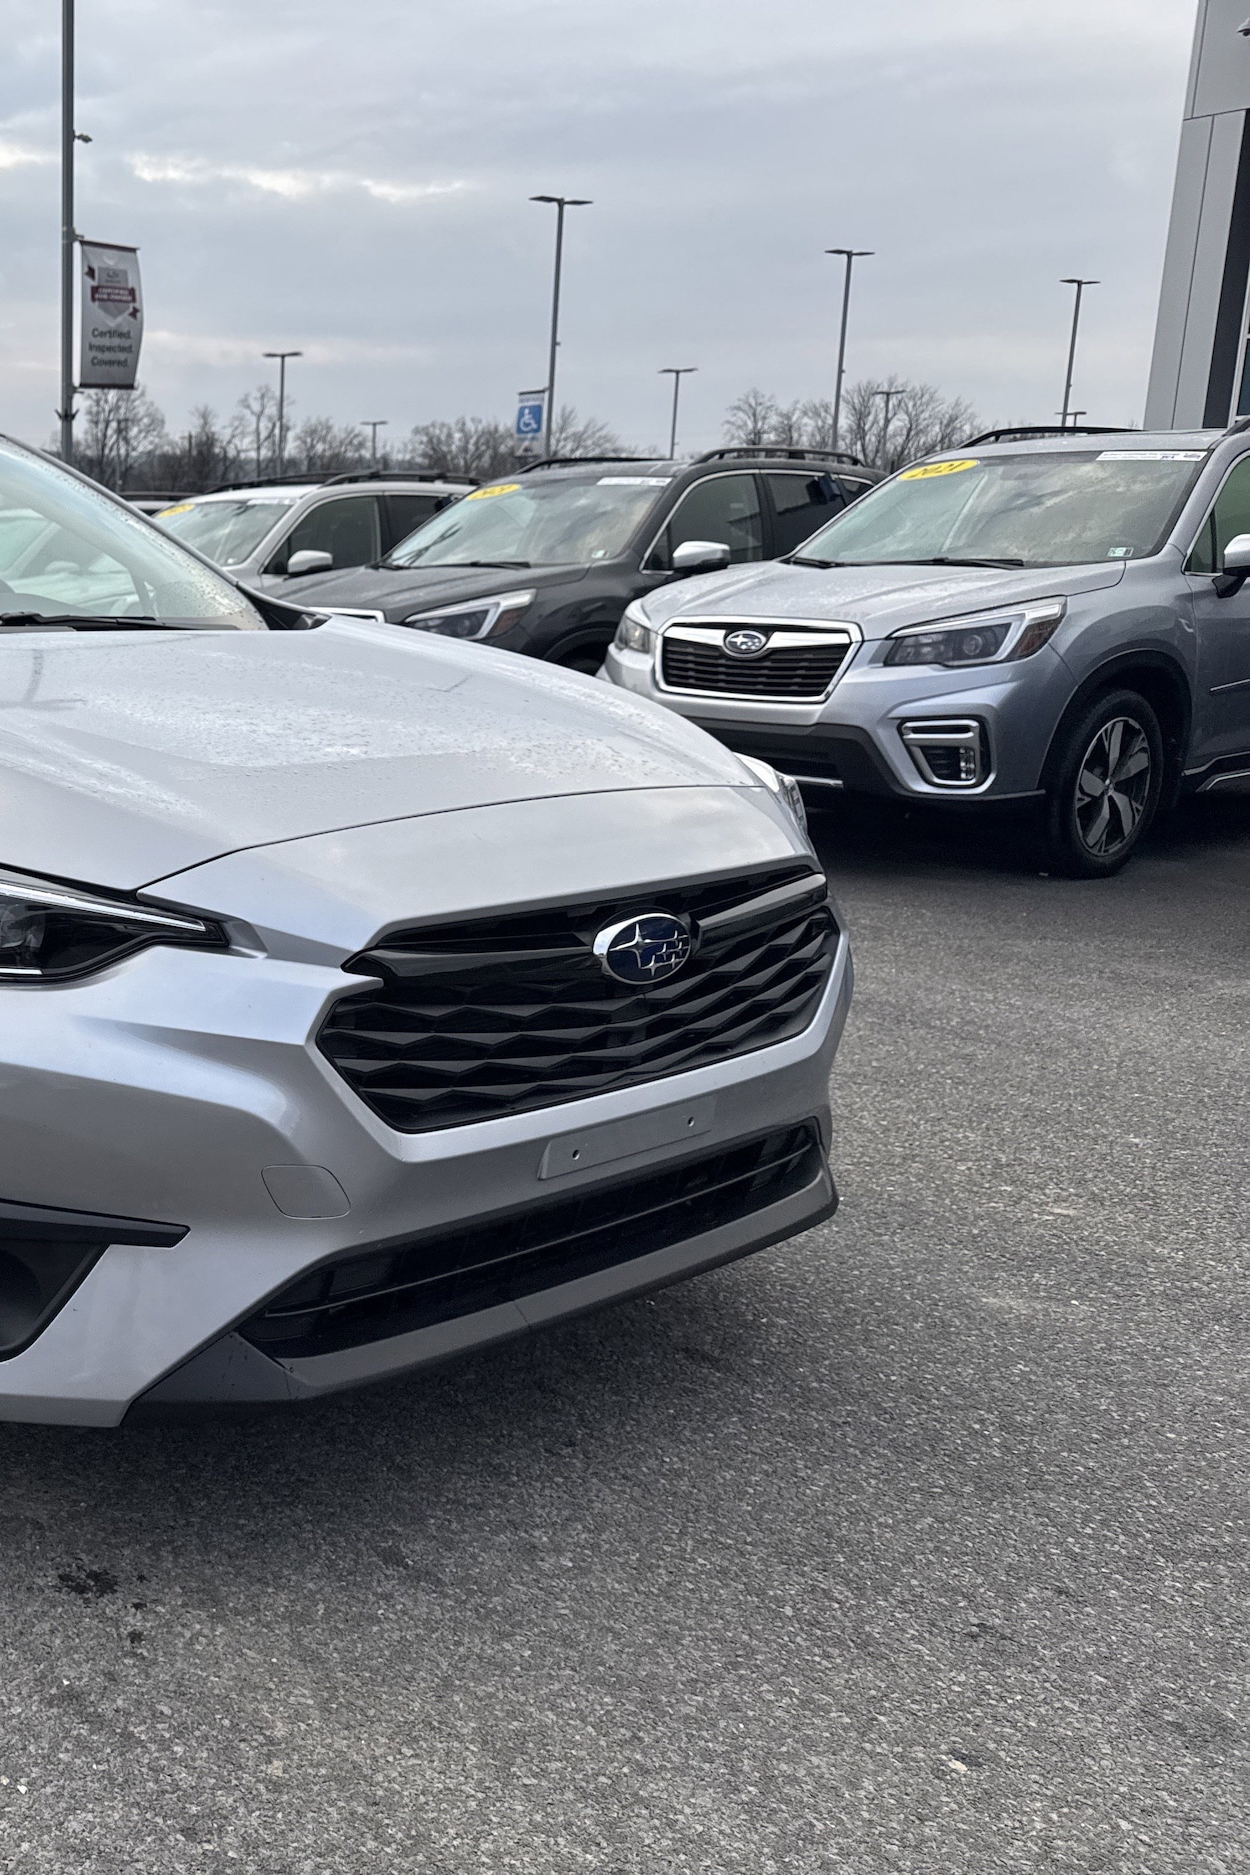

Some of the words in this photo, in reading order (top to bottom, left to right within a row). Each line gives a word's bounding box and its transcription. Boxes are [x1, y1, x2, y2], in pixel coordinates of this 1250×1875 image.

[91, 328, 132, 340] Certified.
[89, 343, 133, 355] Inspected.
[91, 356, 129, 368] Covered.
